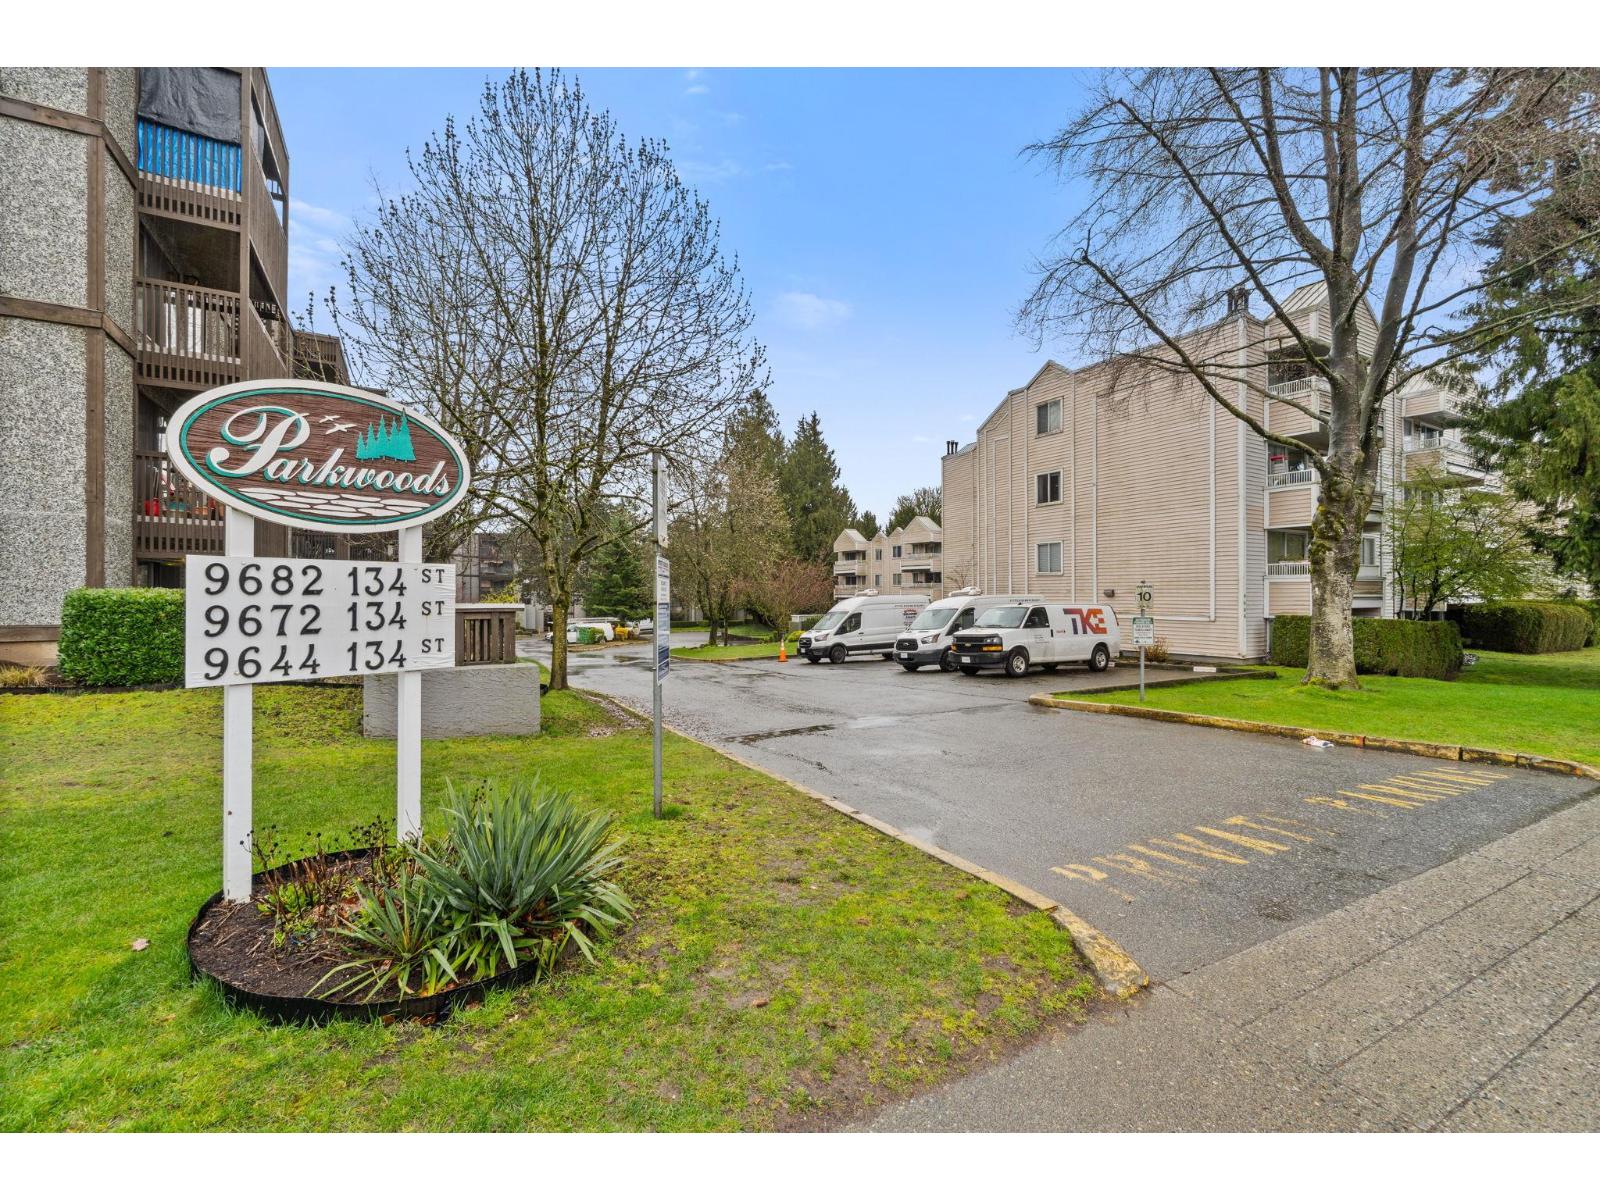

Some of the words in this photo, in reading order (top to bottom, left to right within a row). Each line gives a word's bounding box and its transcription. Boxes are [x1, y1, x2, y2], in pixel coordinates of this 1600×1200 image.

[206, 406, 452, 497] Parkwoods
[204, 562, 324, 596] 9682
[347, 566, 408, 597] 134
[421, 568, 446, 584] ST
[1136, 591, 1152, 602] 10
[204, 604, 323, 638] 9672
[347, 601, 407, 632] 134
[421, 600, 446, 616] ST
[1063, 608, 1107, 635] TKE
[203, 643, 321, 680] 9644
[347, 639, 407, 672] 134
[421, 637, 446, 653] ST
